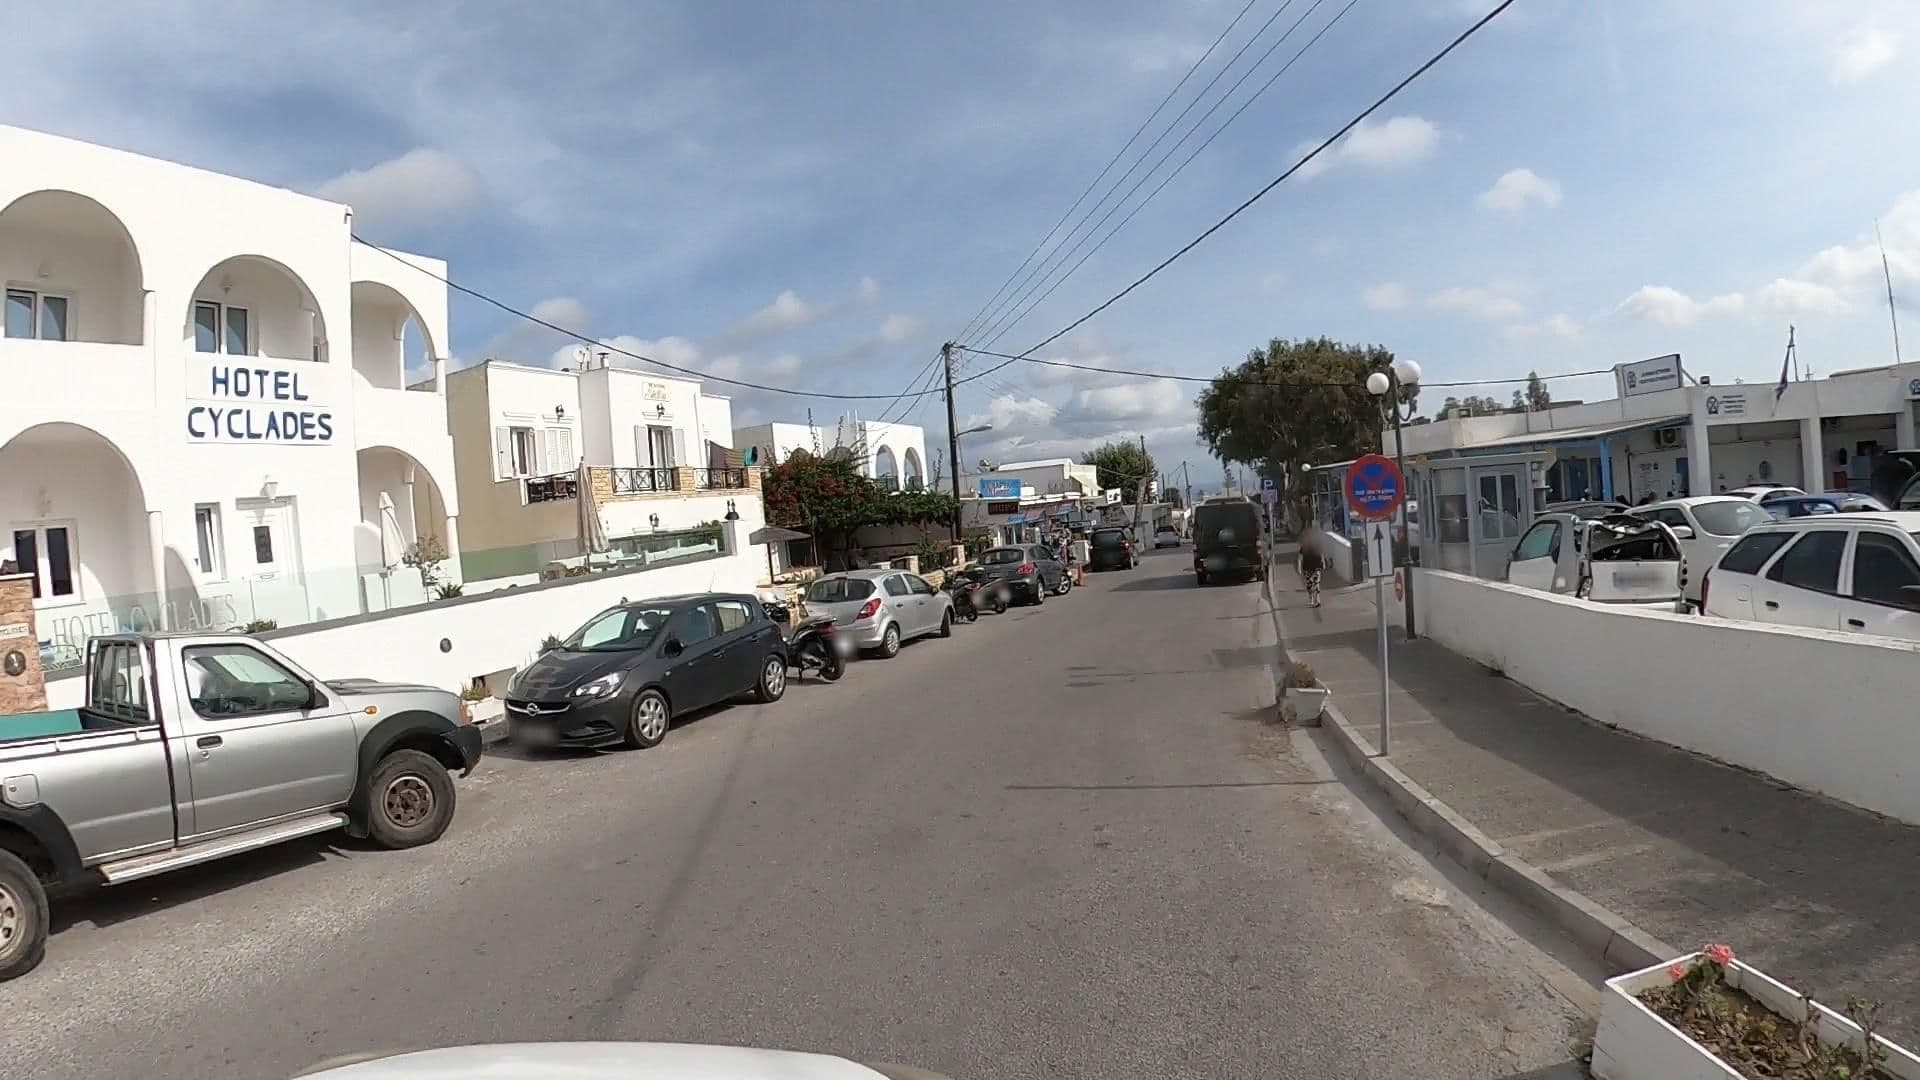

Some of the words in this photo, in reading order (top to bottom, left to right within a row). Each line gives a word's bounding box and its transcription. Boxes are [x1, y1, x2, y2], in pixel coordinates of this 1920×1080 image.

[212, 366, 309, 401] HOTEL
[187, 407, 333, 441] CYCLADES
[1263, 479, 1273, 490] P
